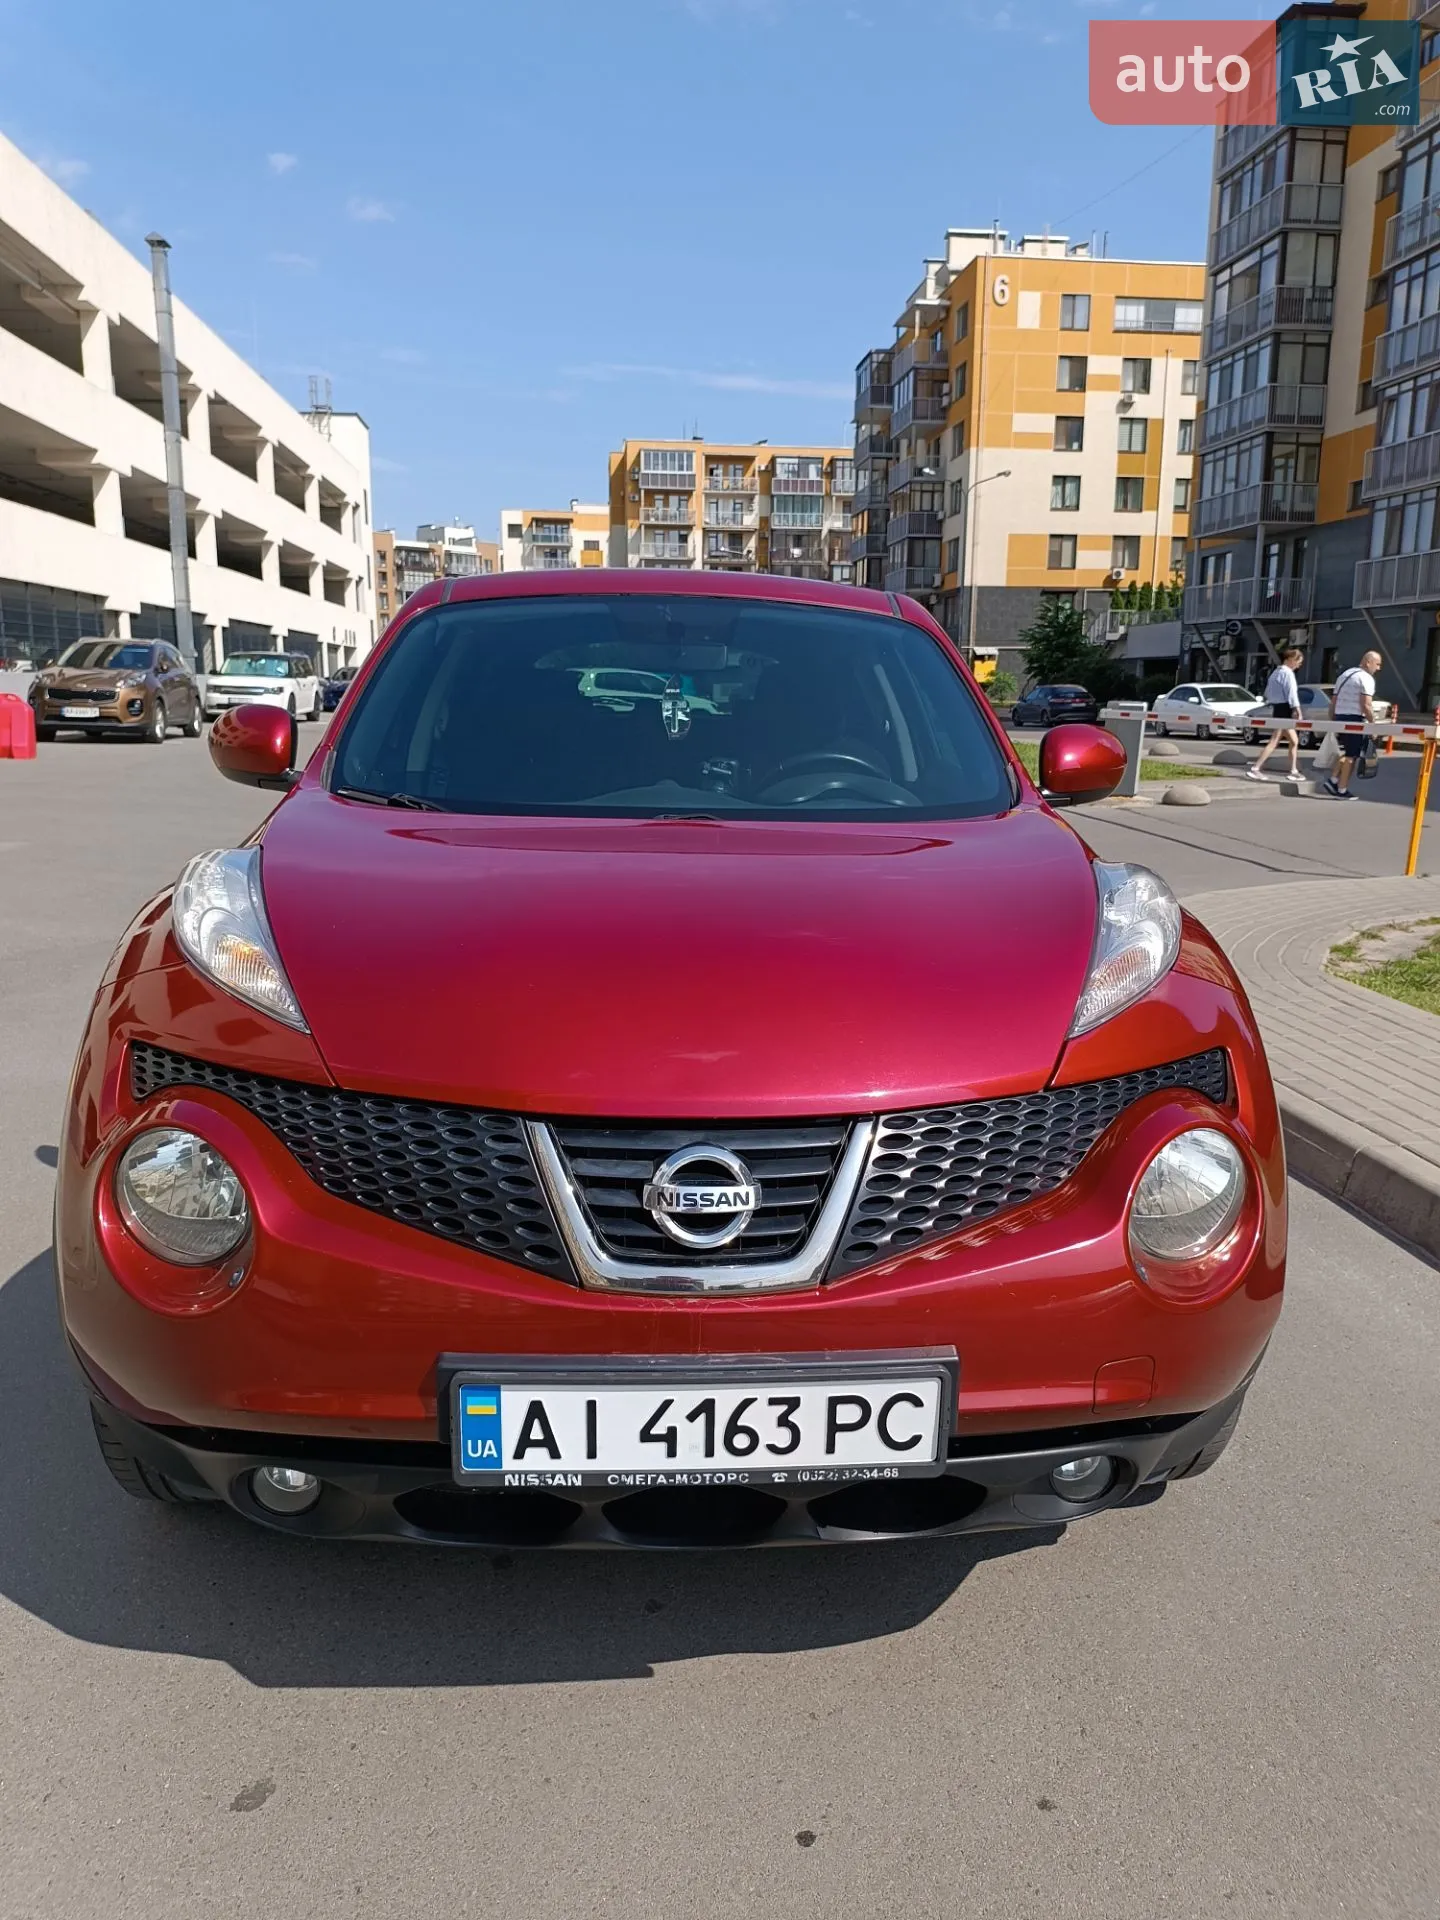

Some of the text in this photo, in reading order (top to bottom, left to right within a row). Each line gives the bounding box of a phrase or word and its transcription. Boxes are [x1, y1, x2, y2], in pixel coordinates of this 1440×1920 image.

[993, 274, 1010, 306] 6
[656, 1191, 750, 1208] NISSAN
[639, 1396, 802, 1458] 4163
[825, 1392, 925, 1455] PC
[467, 1439, 498, 1458] UA
[504, 1473, 582, 1487] NISSAN
